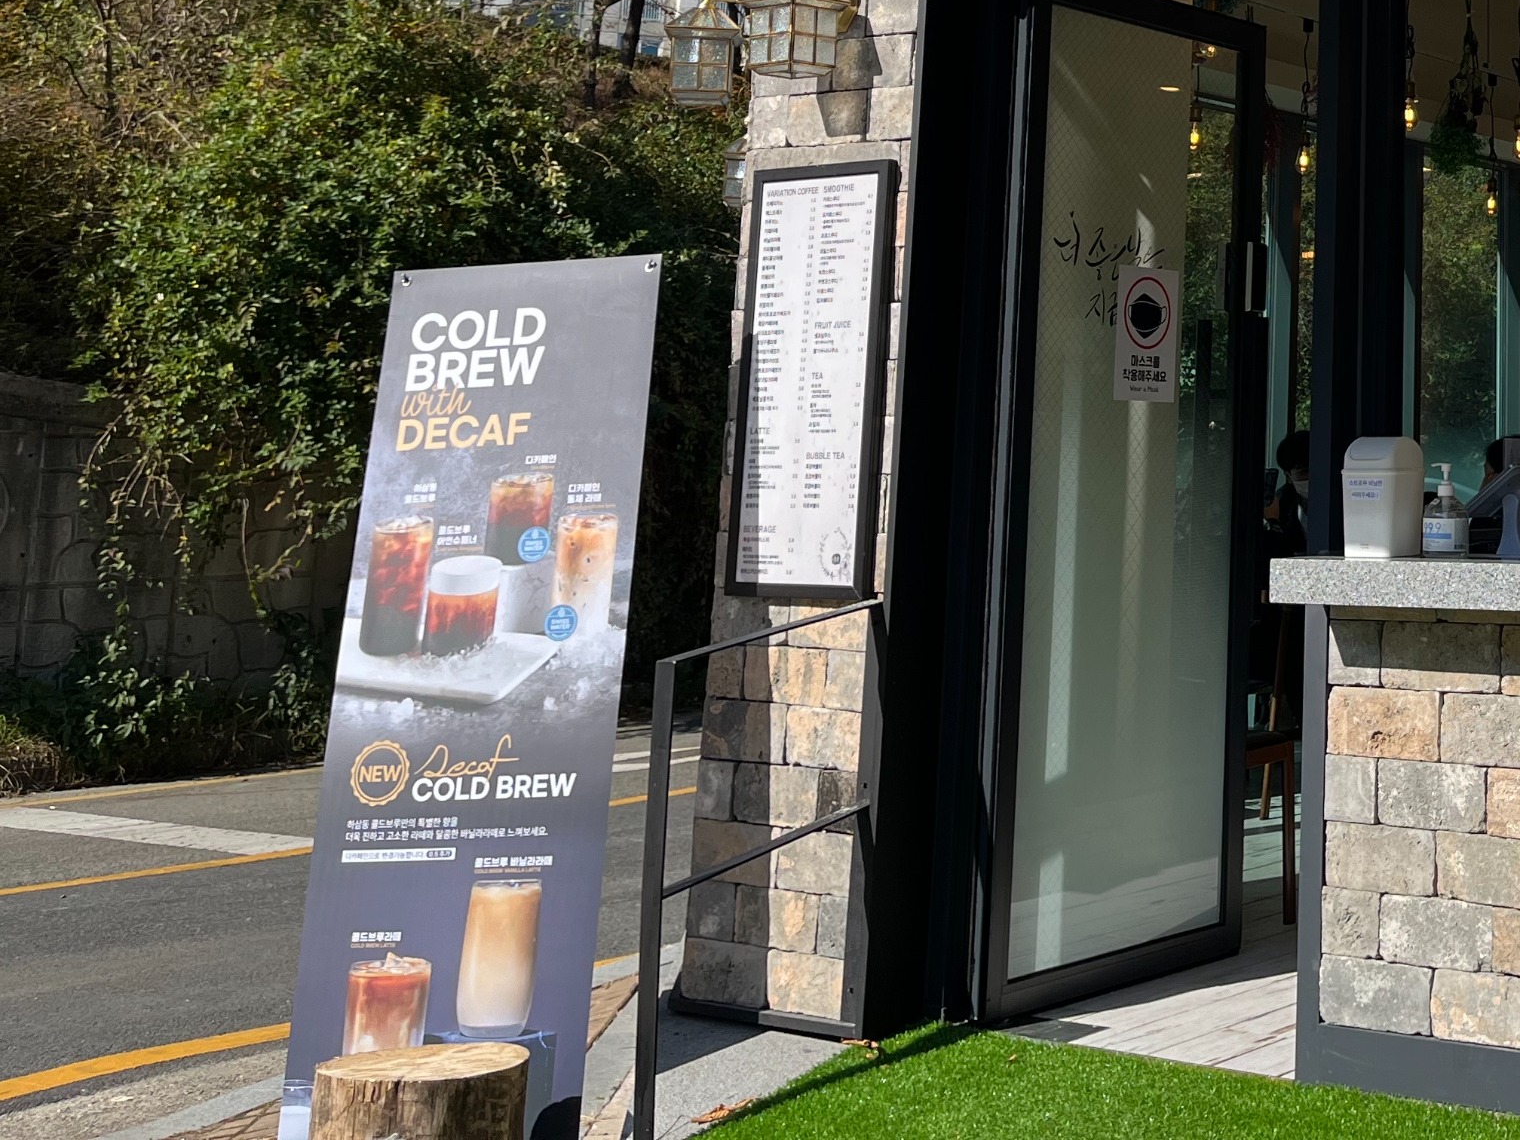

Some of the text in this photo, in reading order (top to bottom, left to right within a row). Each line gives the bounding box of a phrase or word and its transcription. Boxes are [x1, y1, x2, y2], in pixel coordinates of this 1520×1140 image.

[767, 186, 819, 197] VARIATION COFFEE
[823, 184, 854, 193] SMOOTHIE
[411, 307, 547, 352] COLD
[814, 320, 851, 329] FRUIT JUICE
[1131, 354, 1160, 368] 마스크를
[405, 346, 546, 392] BREW
[1123, 369, 1167, 382] 착용해주세요
[812, 372, 823, 380] TEA
[400, 383, 471, 417] with
[395, 412, 532, 452] DECAF
[750, 427, 770, 435] LATTE
[806, 452, 845, 460] BUBBLE TEA
[743, 525, 777, 533] BEVERAGE
[359, 764, 402, 783] NEW
[412, 772, 577, 802] COLD BREW
